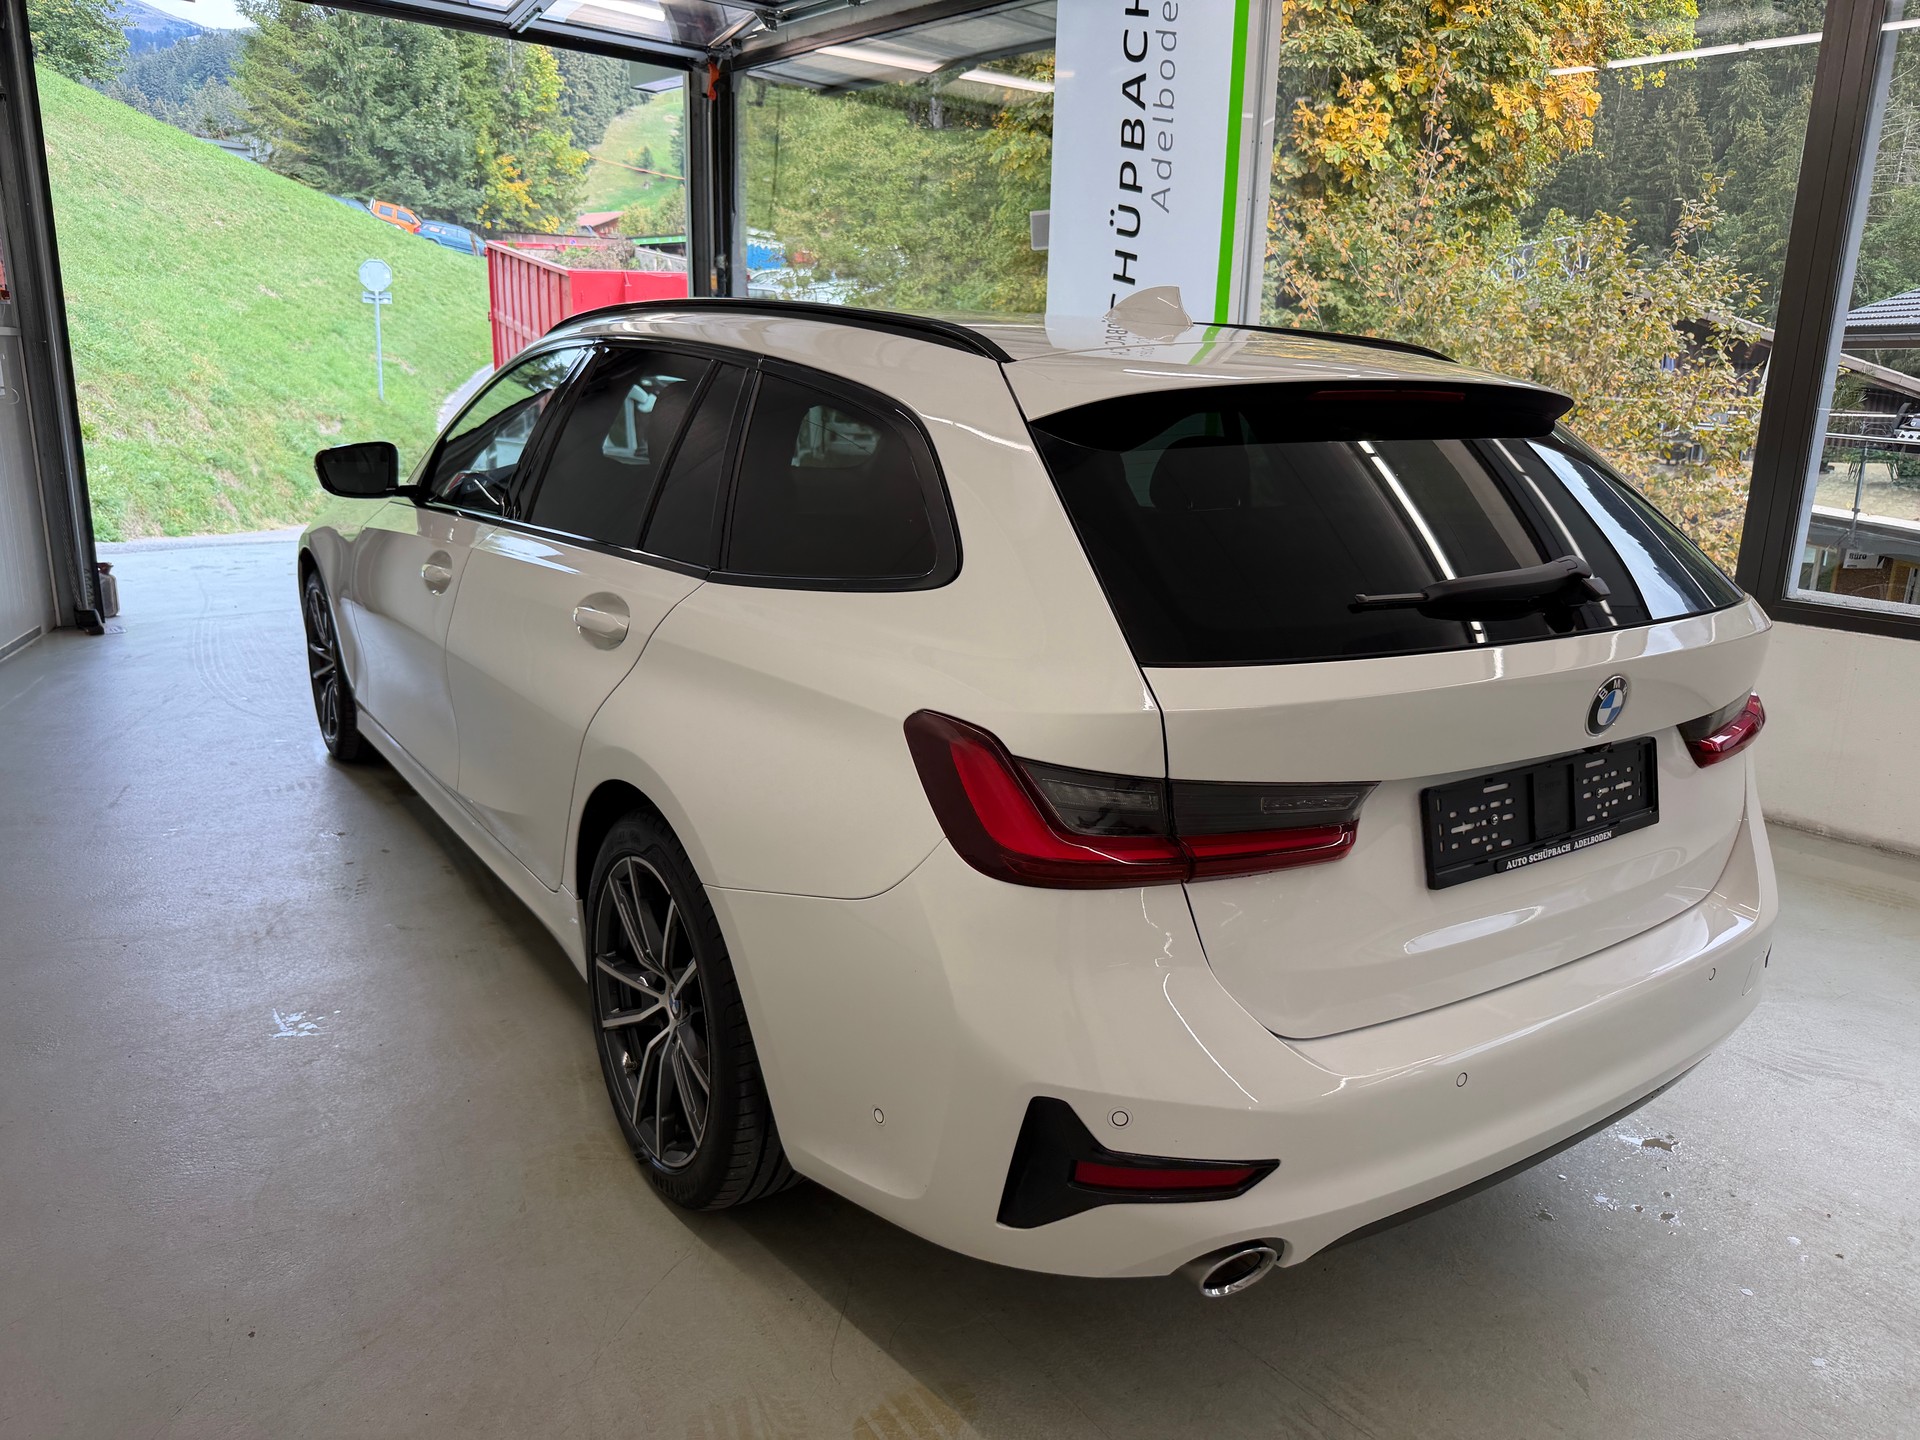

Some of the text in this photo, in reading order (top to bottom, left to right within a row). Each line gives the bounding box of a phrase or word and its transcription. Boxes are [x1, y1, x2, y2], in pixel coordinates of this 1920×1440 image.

[1109, 0, 1149, 310] HÜPBAC
[1151, 0, 1179, 213] Adelbode
[1598, 678, 1628, 701] BMW
[1506, 830, 1613, 870] AUTO SCHÜPBACH ADELBODEN
